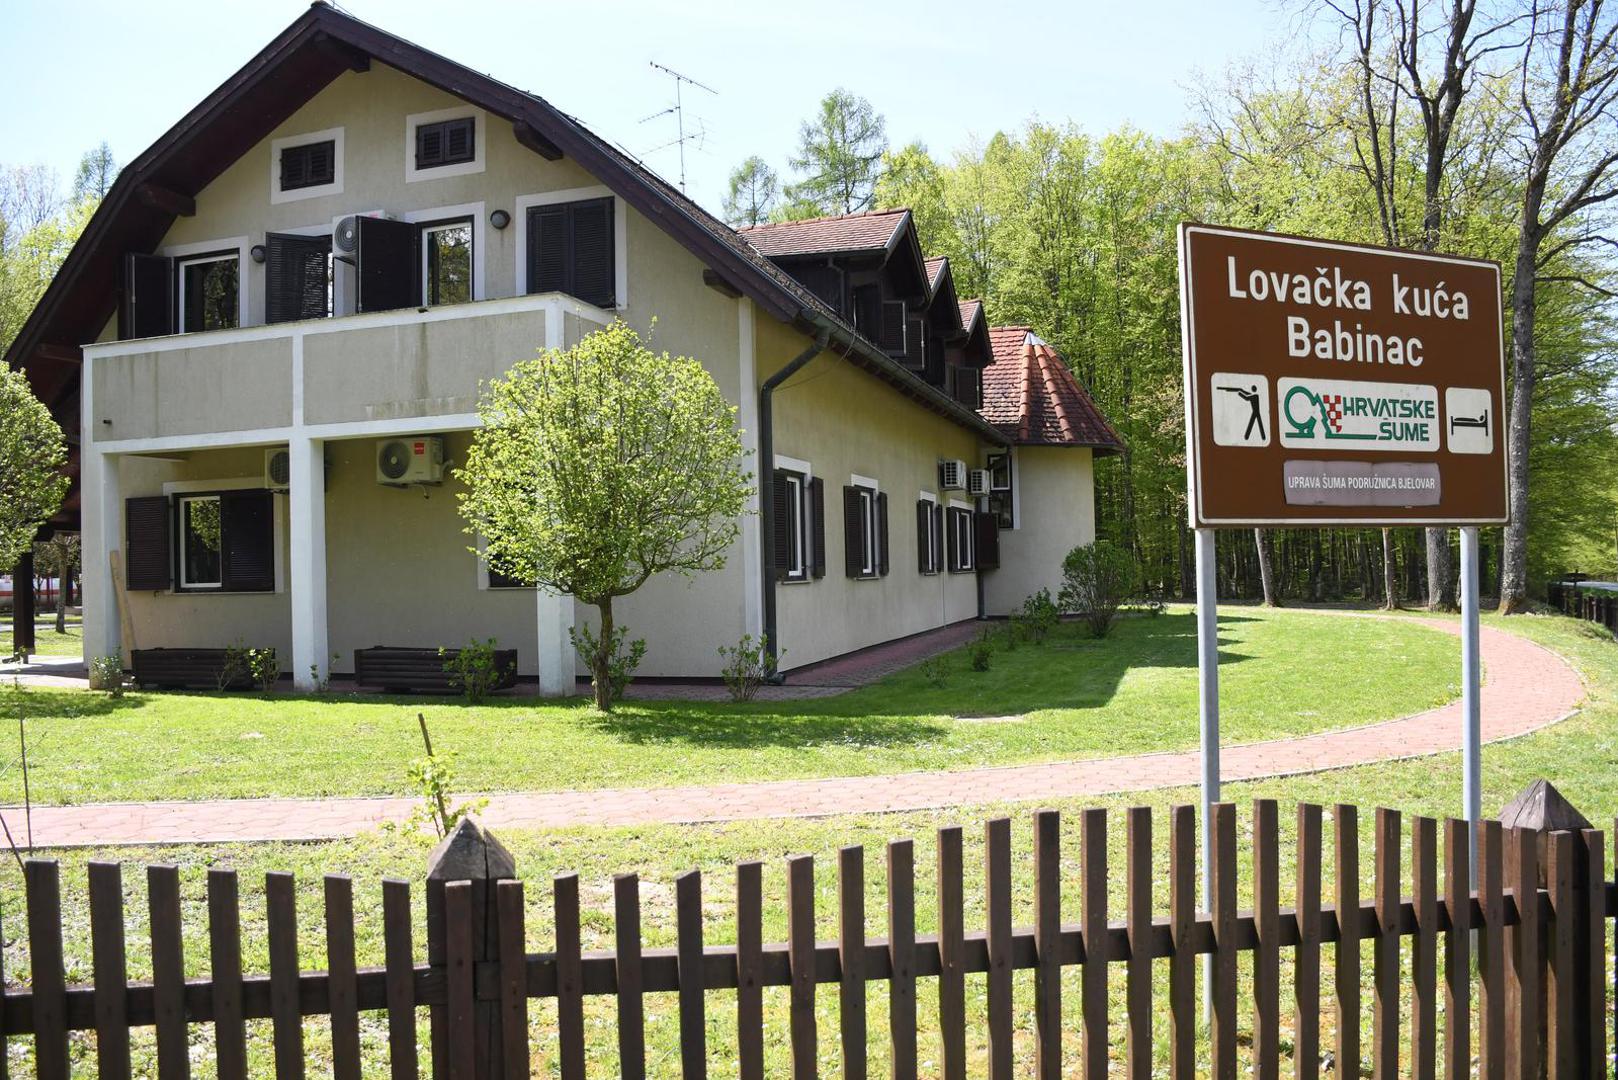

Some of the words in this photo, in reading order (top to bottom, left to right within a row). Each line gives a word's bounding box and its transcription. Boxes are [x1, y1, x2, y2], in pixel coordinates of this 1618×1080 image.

[1228, 256, 1371, 310] Lovačka
[1393, 273, 1469, 320] kuća
[1287, 316, 1424, 367] Babinac
[1343, 397, 1435, 419] HRVATSKE
[1378, 417, 1430, 442] ŠUME
[1288, 476, 1320, 489] UPRAVA
[1322, 473, 1346, 489] ŠUMA
[1398, 477, 1435, 489] BJELOVAR
